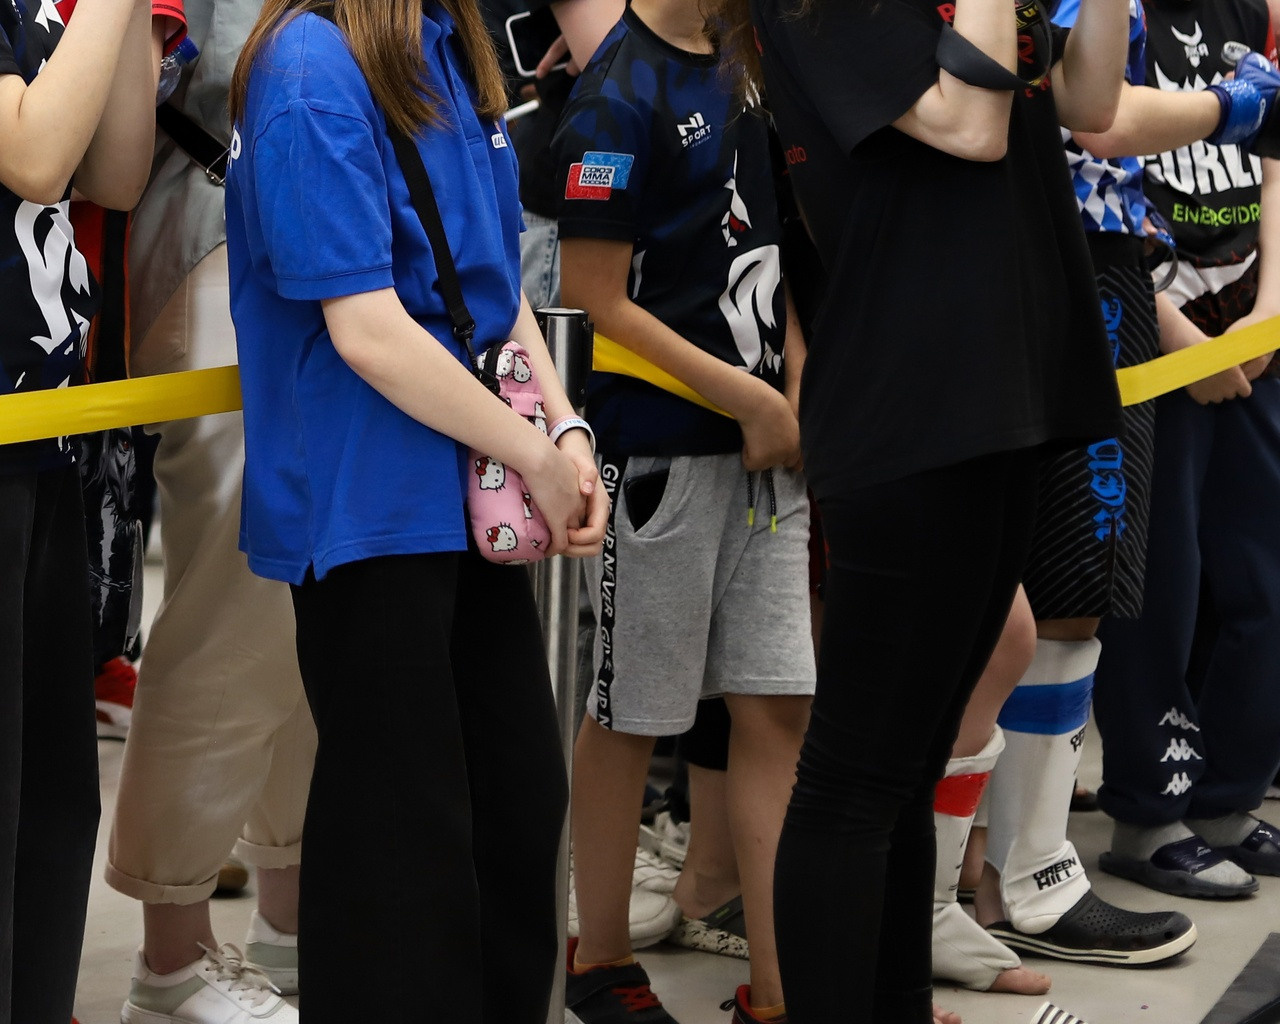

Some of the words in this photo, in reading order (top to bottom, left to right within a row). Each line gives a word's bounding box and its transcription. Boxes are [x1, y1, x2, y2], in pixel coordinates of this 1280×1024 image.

[681, 123, 712, 148] SPORT
[581, 172, 610, 181] ММА
[583, 166, 613, 174] СОЮЗ
[602, 553, 616, 618] NEVER
[597, 679, 608, 709] UP
[1032, 856, 1078, 882] GREEN
[1036, 869, 1076, 890] HILL
